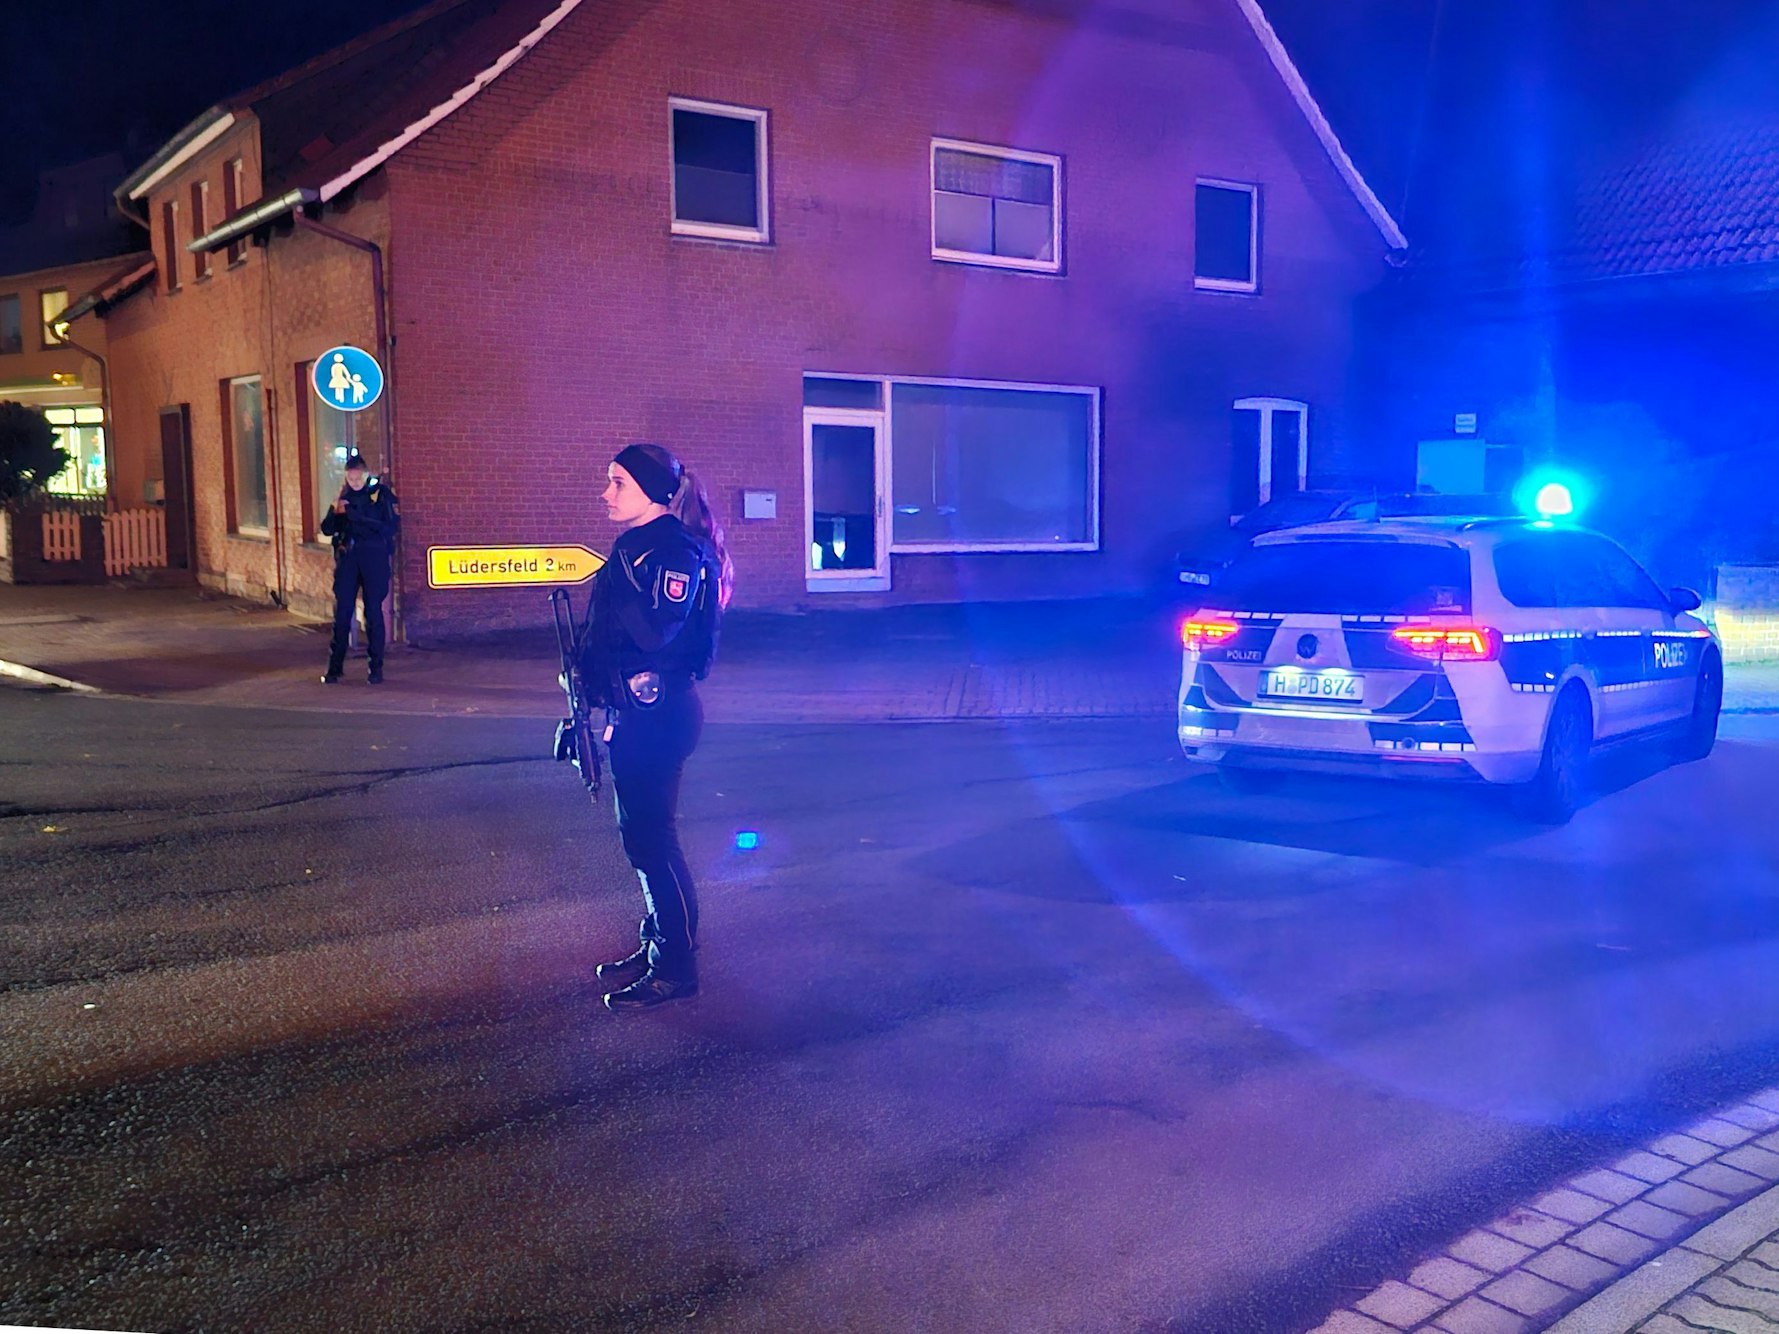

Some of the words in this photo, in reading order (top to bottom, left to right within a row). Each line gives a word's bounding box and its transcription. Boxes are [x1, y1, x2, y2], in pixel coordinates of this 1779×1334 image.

[449, 559, 538, 574] Lüdersfeld
[545, 558, 554, 572] 2
[558, 561, 577, 572] km
[1226, 650, 1262, 661] POLIZEI
[1274, 675, 1286, 693] H
[1298, 676, 1319, 694] PD
[1322, 678, 1356, 697] 874
